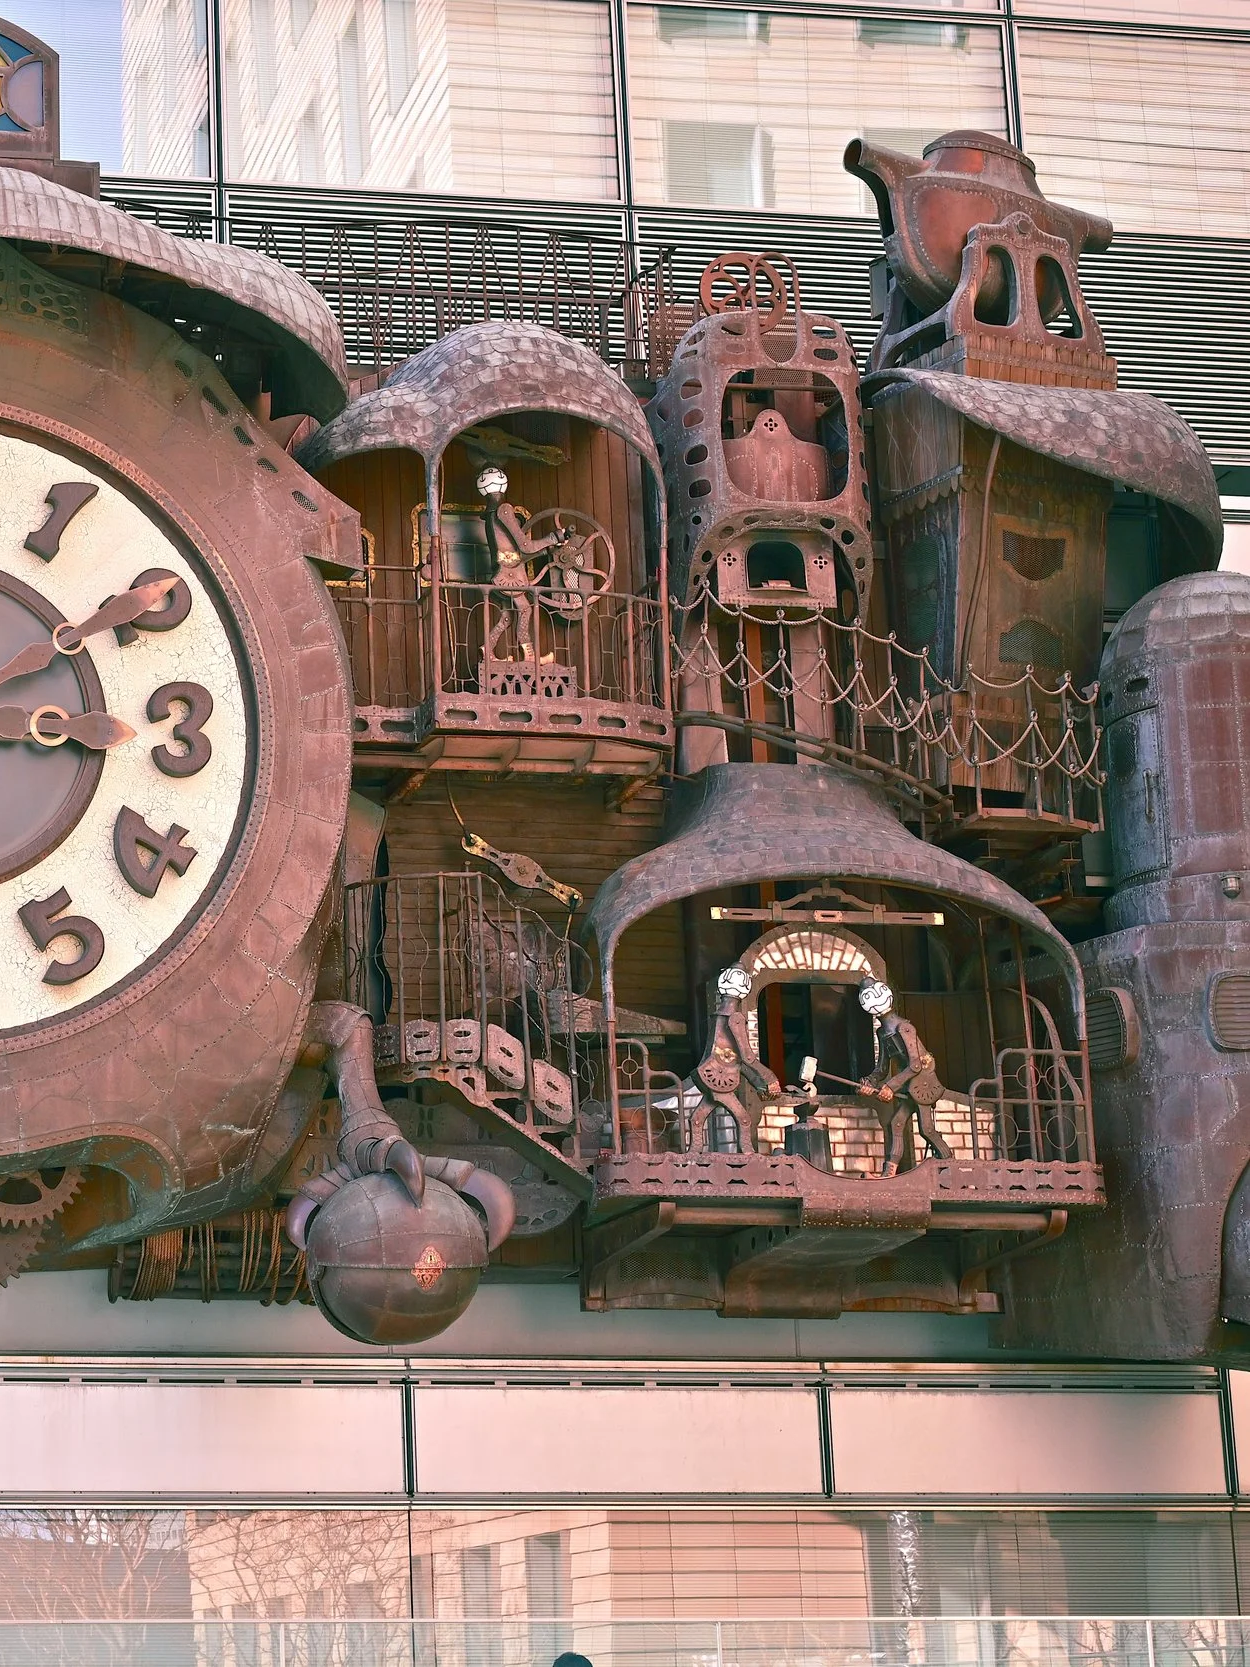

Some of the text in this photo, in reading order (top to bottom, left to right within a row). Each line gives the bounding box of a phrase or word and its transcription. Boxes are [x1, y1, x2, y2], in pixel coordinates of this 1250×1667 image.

[24, 482, 99, 562] 1
[146, 681, 213, 778] 3
[113, 805, 198, 898] 4
[18, 886, 105, 985] 5
